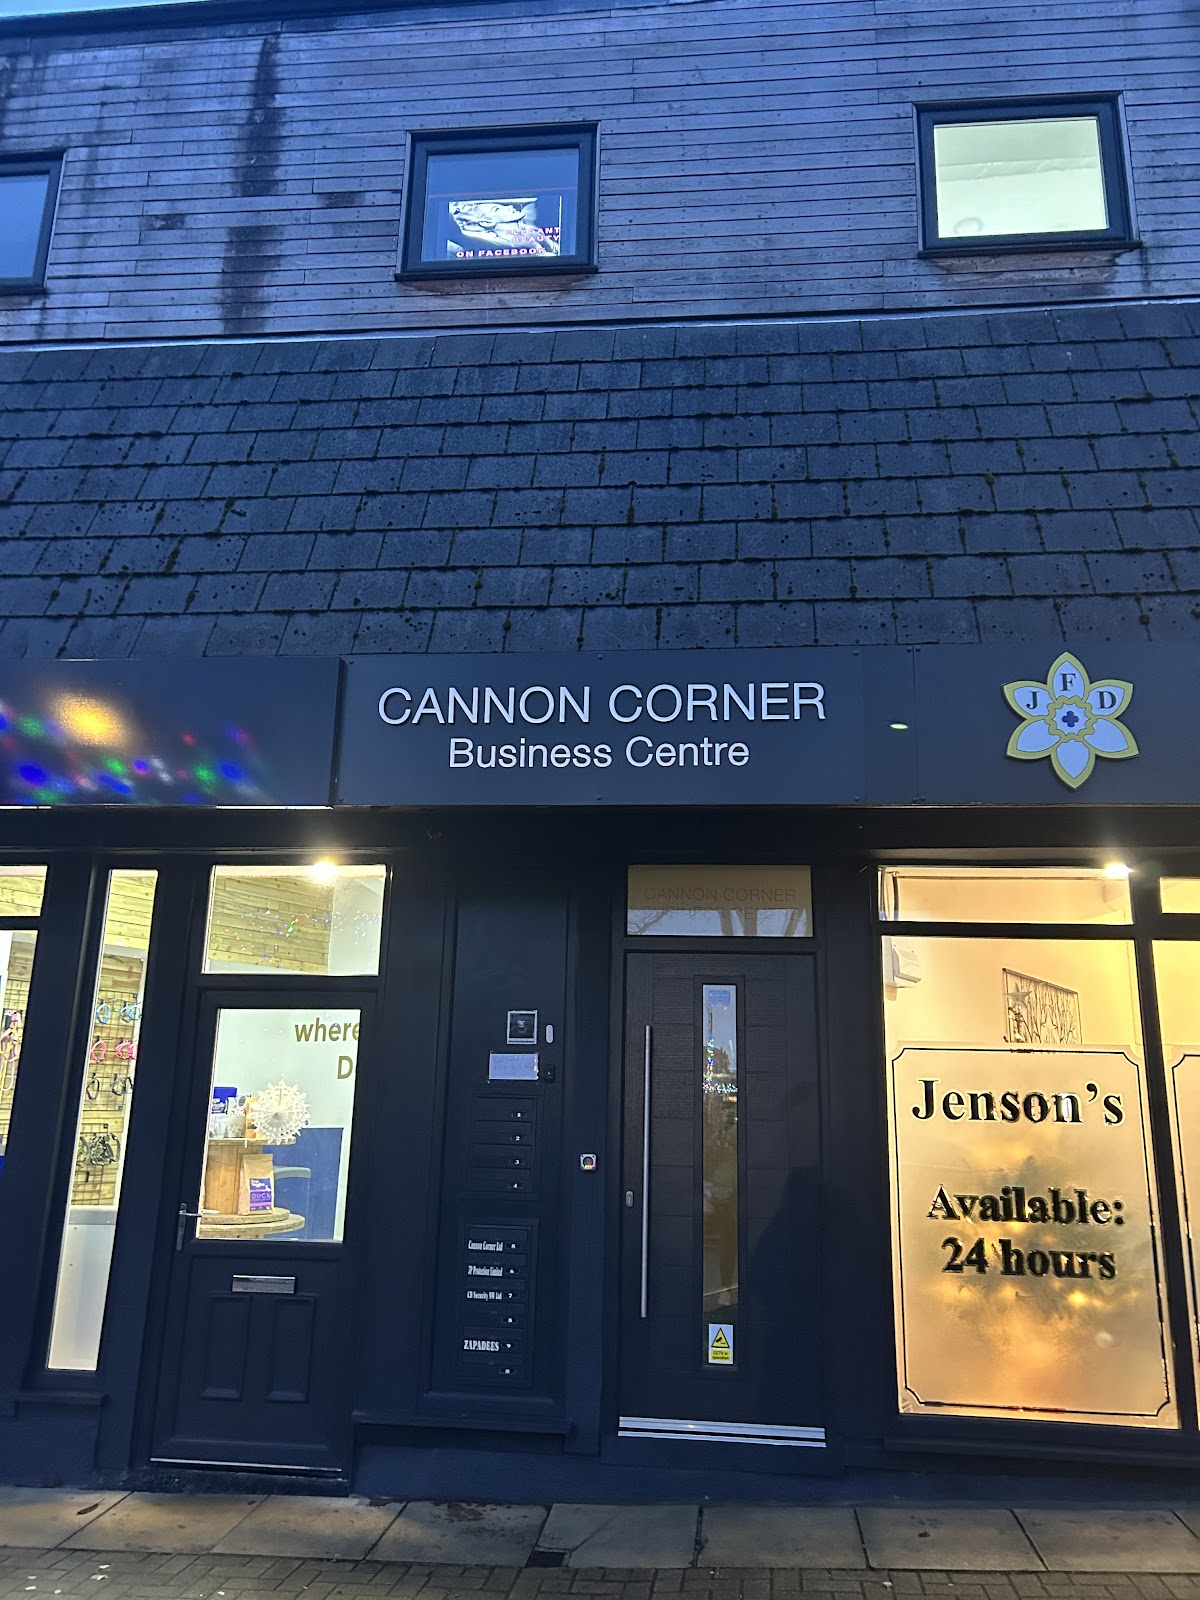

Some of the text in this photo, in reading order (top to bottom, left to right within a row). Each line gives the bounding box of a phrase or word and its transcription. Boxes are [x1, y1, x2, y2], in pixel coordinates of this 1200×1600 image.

[505, 227, 560, 236] ELEGANT
[513, 235, 560, 243] BEAUTY
[455, 247, 547, 258] ON FACEBOOK
[377, 682, 827, 726] CANNON CORNER
[448, 735, 750, 769] Business Centre
[644, 887, 796, 902] CANNON CORNER
[926, 1183, 1126, 1227] Available:
[941, 1236, 1119, 1280] 24 hours
[463, 1339, 500, 1352] ZAPADEES
